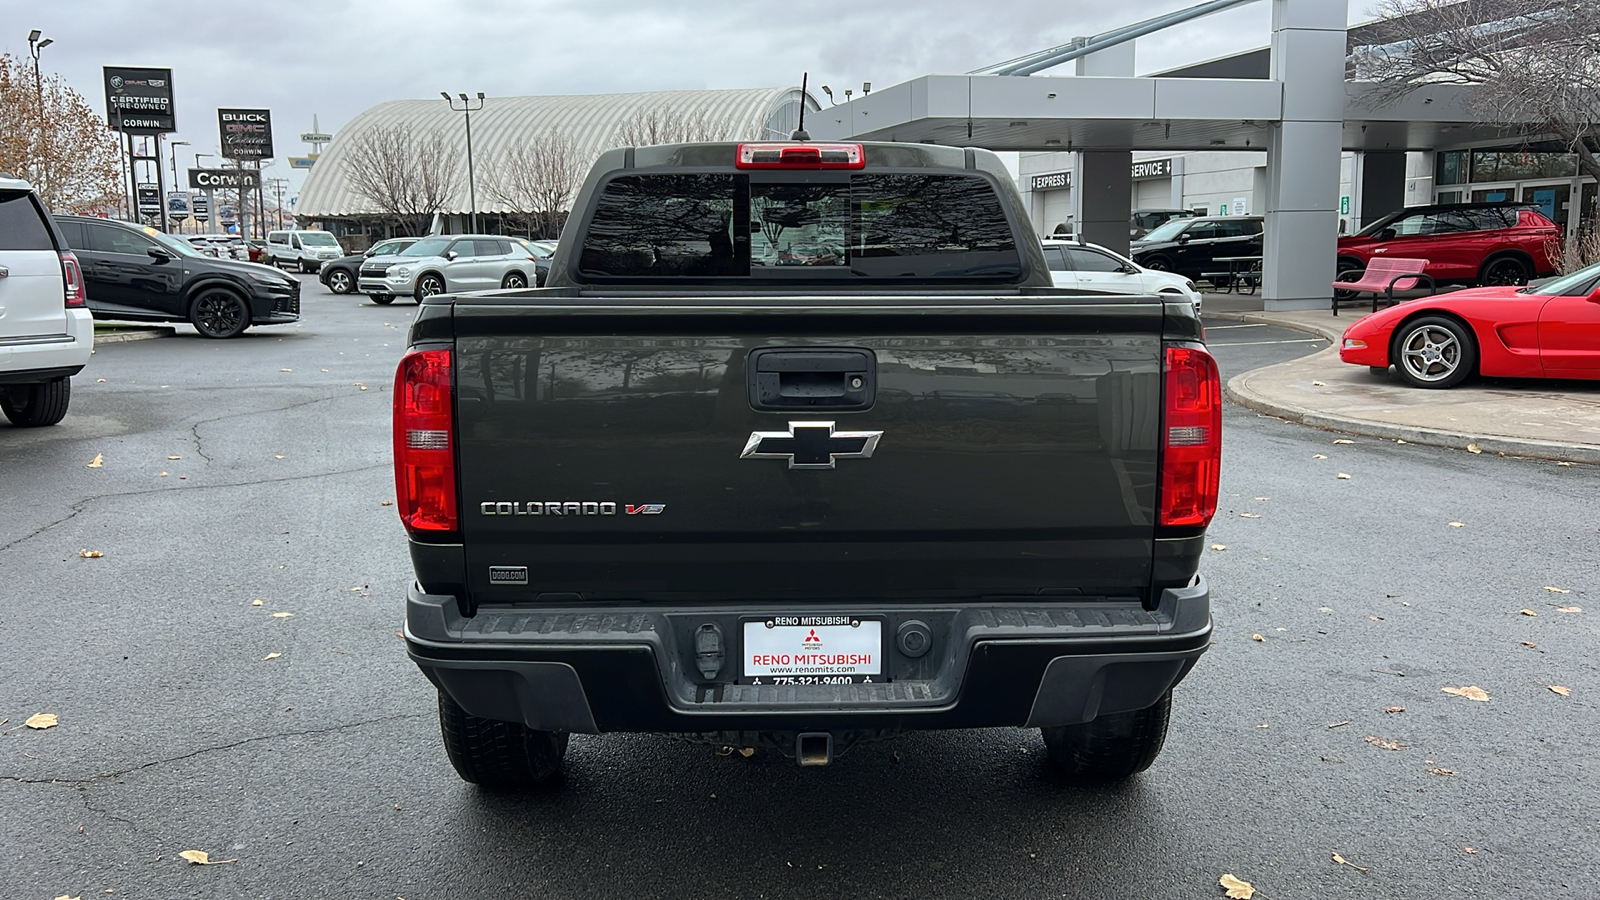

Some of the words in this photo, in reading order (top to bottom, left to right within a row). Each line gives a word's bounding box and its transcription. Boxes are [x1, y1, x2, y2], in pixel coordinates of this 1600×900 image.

[110, 96, 169, 104] CERTIFIED
[114, 102, 166, 110] PRE-OWNED
[222, 113, 267, 121] BUICK
[123, 119, 160, 127] CORWIN
[226, 124, 265, 132] GMC
[1036, 174, 1065, 188] EXPRESS
[480, 501, 617, 516] COLORADO
[624, 503, 667, 515] V6
[492, 571, 526, 580] DGDG.COM
[775, 617, 799, 626] RENO
[801, 616, 850, 626] MITSUBISHI
[753, 655, 791, 666] RENO
[794, 654, 871, 665] MITSUBISHI
[770, 666, 856, 674] www.renomits.com
[773, 676, 853, 686] 775-321-9400
